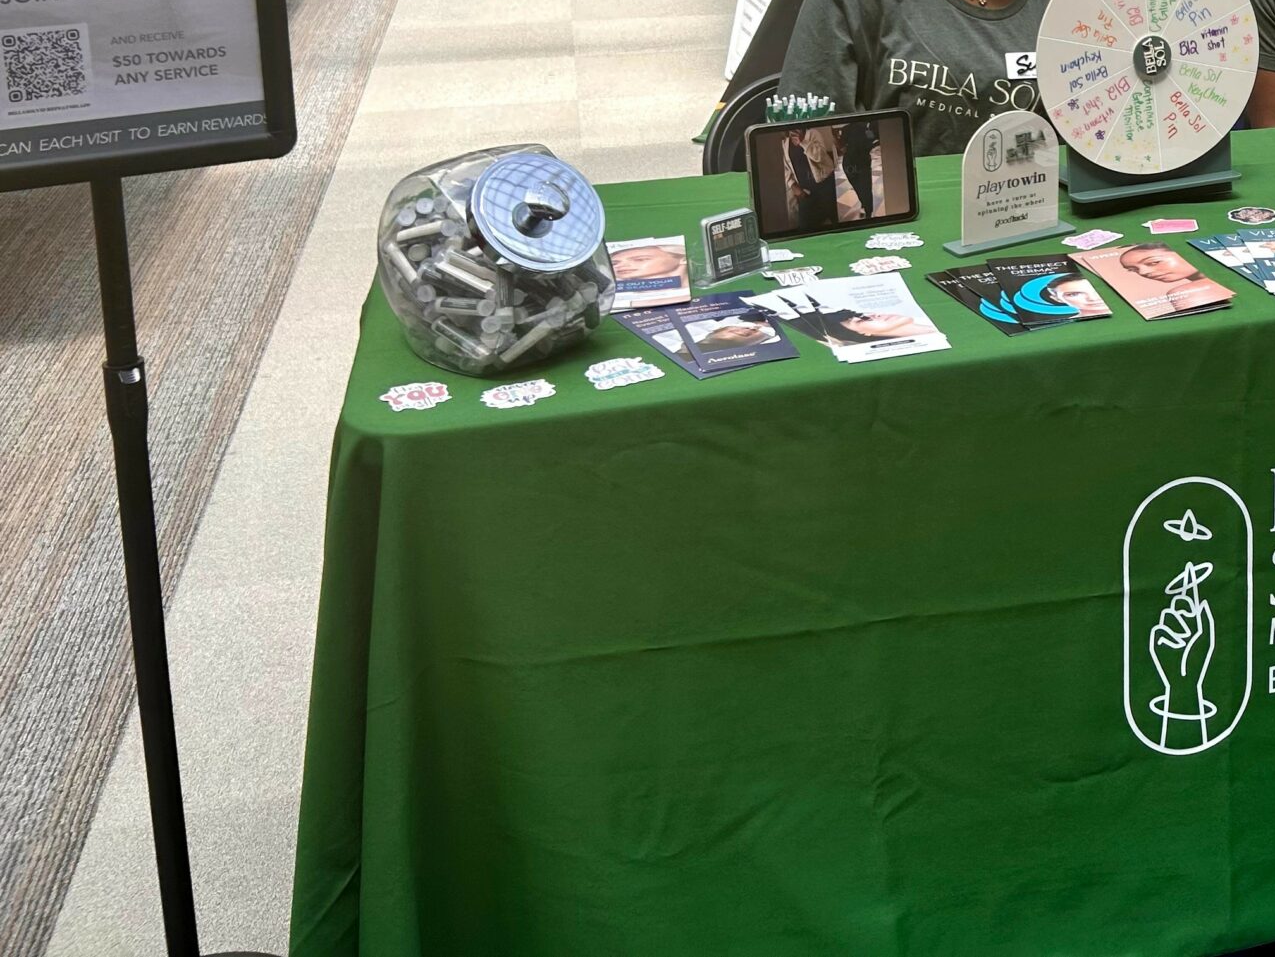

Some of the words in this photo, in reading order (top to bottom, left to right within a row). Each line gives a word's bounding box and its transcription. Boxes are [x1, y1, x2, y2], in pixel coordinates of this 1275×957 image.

[110, 35, 137, 46] AND
[139, 30, 185, 42] RECEIVE
[112, 54, 141, 68] $50
[147, 46, 227, 65] TOWARDS
[114, 71, 149, 86] ANY
[154, 64, 219, 82] SERVICE
[888, 58, 978, 100] BELLA
[916, 97, 979, 118] MEDICAL
[40, 135, 83, 152] EACH
[87, 130, 122, 146] VISIT
[128, 126, 151, 141] TO
[158, 121, 198, 138] EARN
[977, 180, 1005, 199] play
[1007, 178, 1020, 188] to
[1021, 172, 1046, 186] win
[711, 218, 743, 235] SELF-CARE
[1019, 261, 1068, 270] PERFECT
[778, 271, 818, 286] VIBES
